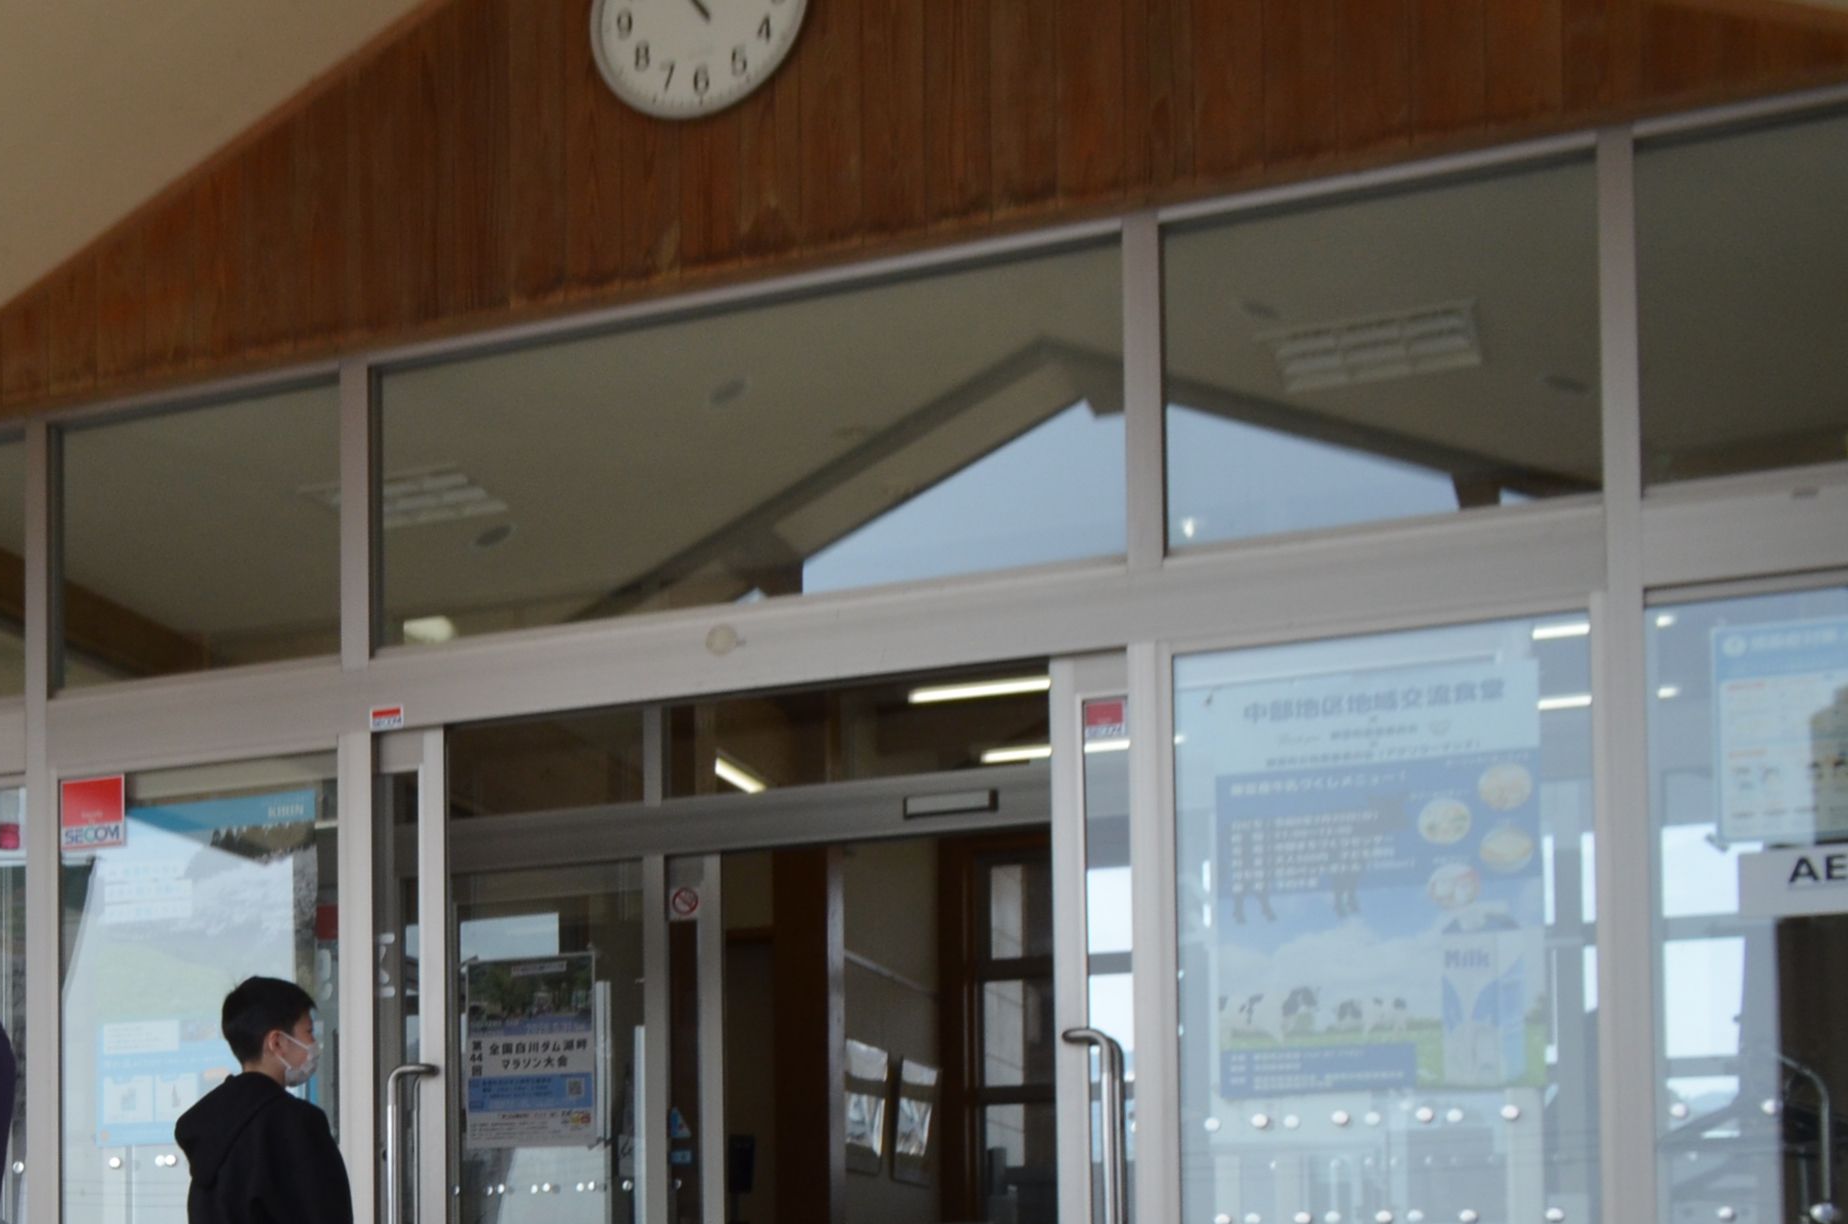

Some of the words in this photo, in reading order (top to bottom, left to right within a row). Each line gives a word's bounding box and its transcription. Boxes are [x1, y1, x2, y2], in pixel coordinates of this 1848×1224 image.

[64, 825, 120, 845] SECOM
[501, 1055, 569, 1071] マラソン大会
